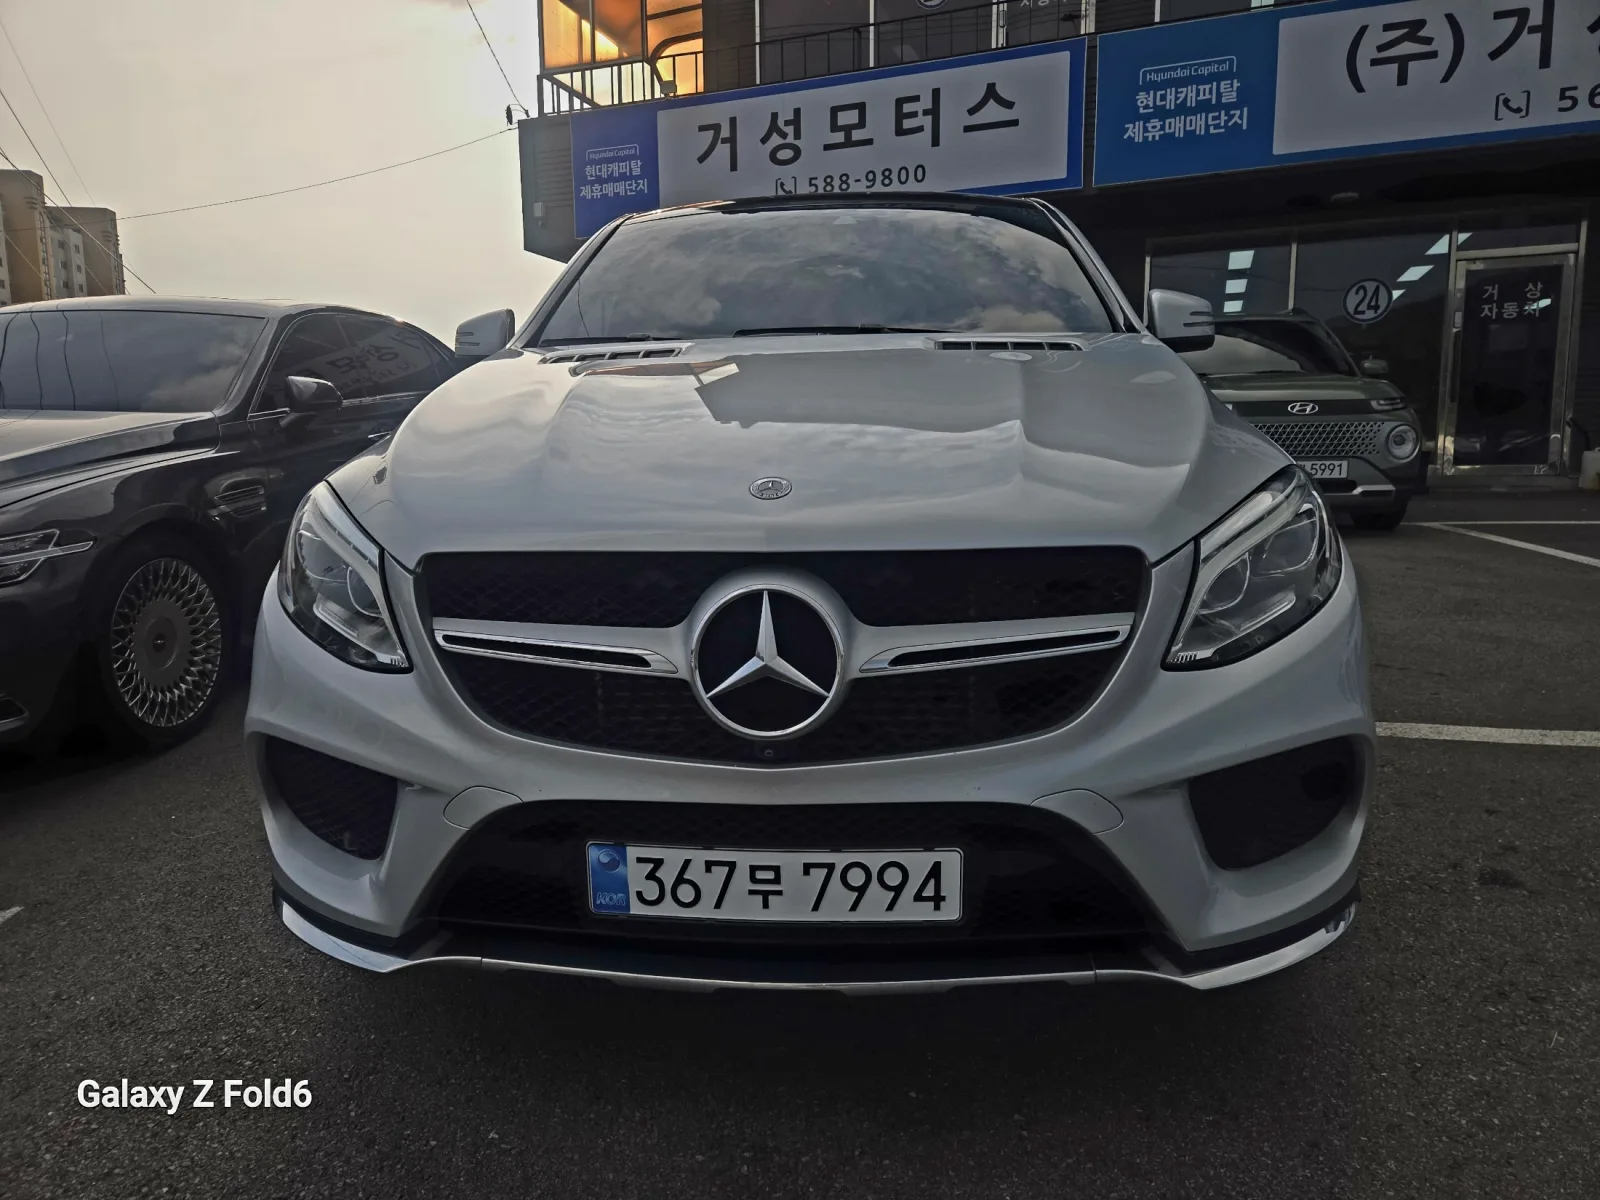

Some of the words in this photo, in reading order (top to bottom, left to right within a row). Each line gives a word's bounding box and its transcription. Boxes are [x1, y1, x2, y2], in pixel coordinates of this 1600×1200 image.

[1346, 0, 1600, 93] (주)거
[1146, 66, 1190, 84] Hyundai
[1191, 61, 1230, 79] Capital
[1135, 77, 1241, 114] 현대캐피탈
[696, 81, 1021, 173] 거성모터스
[1123, 106, 1248, 143] 제휴매매단지
[589, 150, 614, 160] Hyundai
[614, 147, 636, 157] Capital
[585, 160, 643, 180] 현대캐피탈
[808, 164, 927, 193] 588-9800
[579, 178, 648, 200] 제휴매매단지
[1352, 283, 1381, 316] 24
[596, 891, 626, 906] KOR
